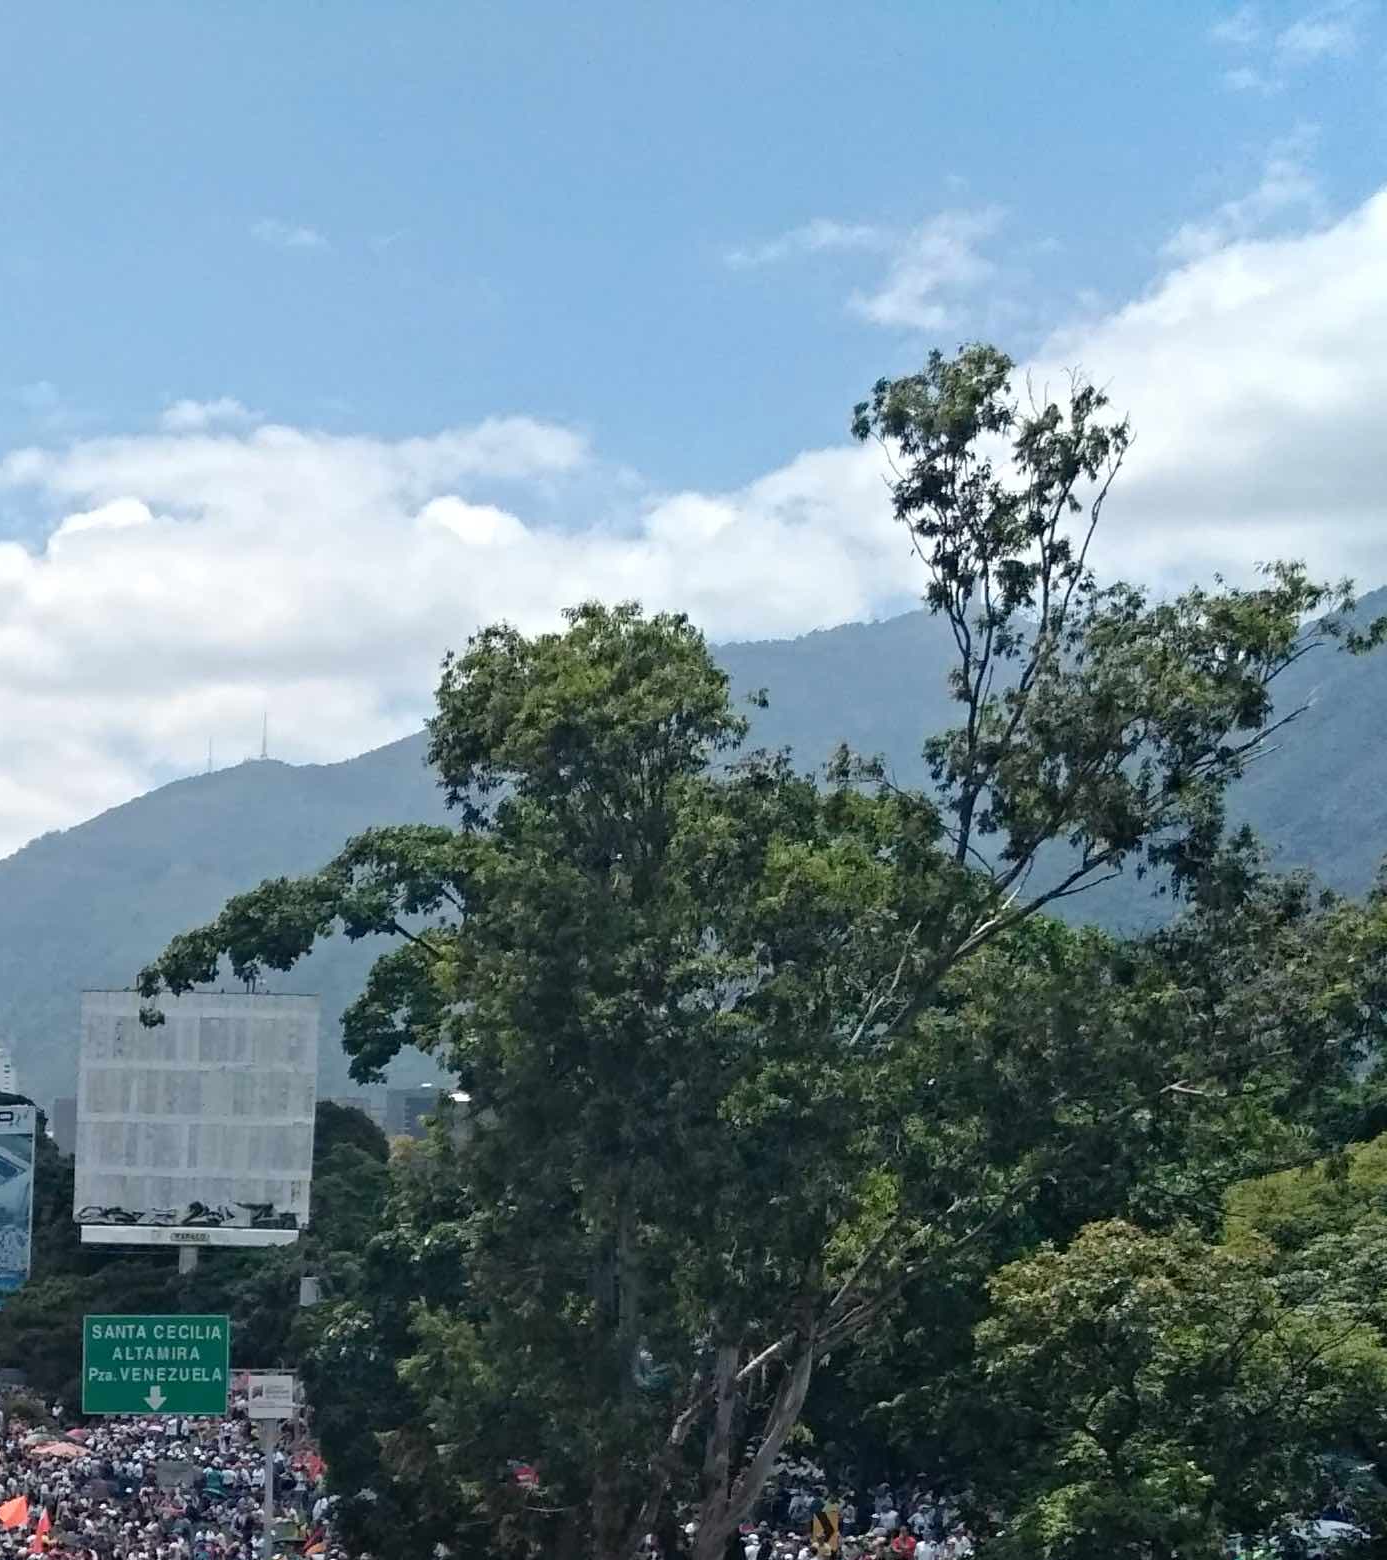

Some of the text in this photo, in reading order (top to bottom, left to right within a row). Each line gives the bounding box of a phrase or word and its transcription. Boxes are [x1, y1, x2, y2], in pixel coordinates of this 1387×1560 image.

[91, 1324, 222, 1340] SANTA CECILIA
[112, 1346, 200, 1361] ALTAMIRA
[88, 1367, 222, 1382] Pza. VENEZUELA
